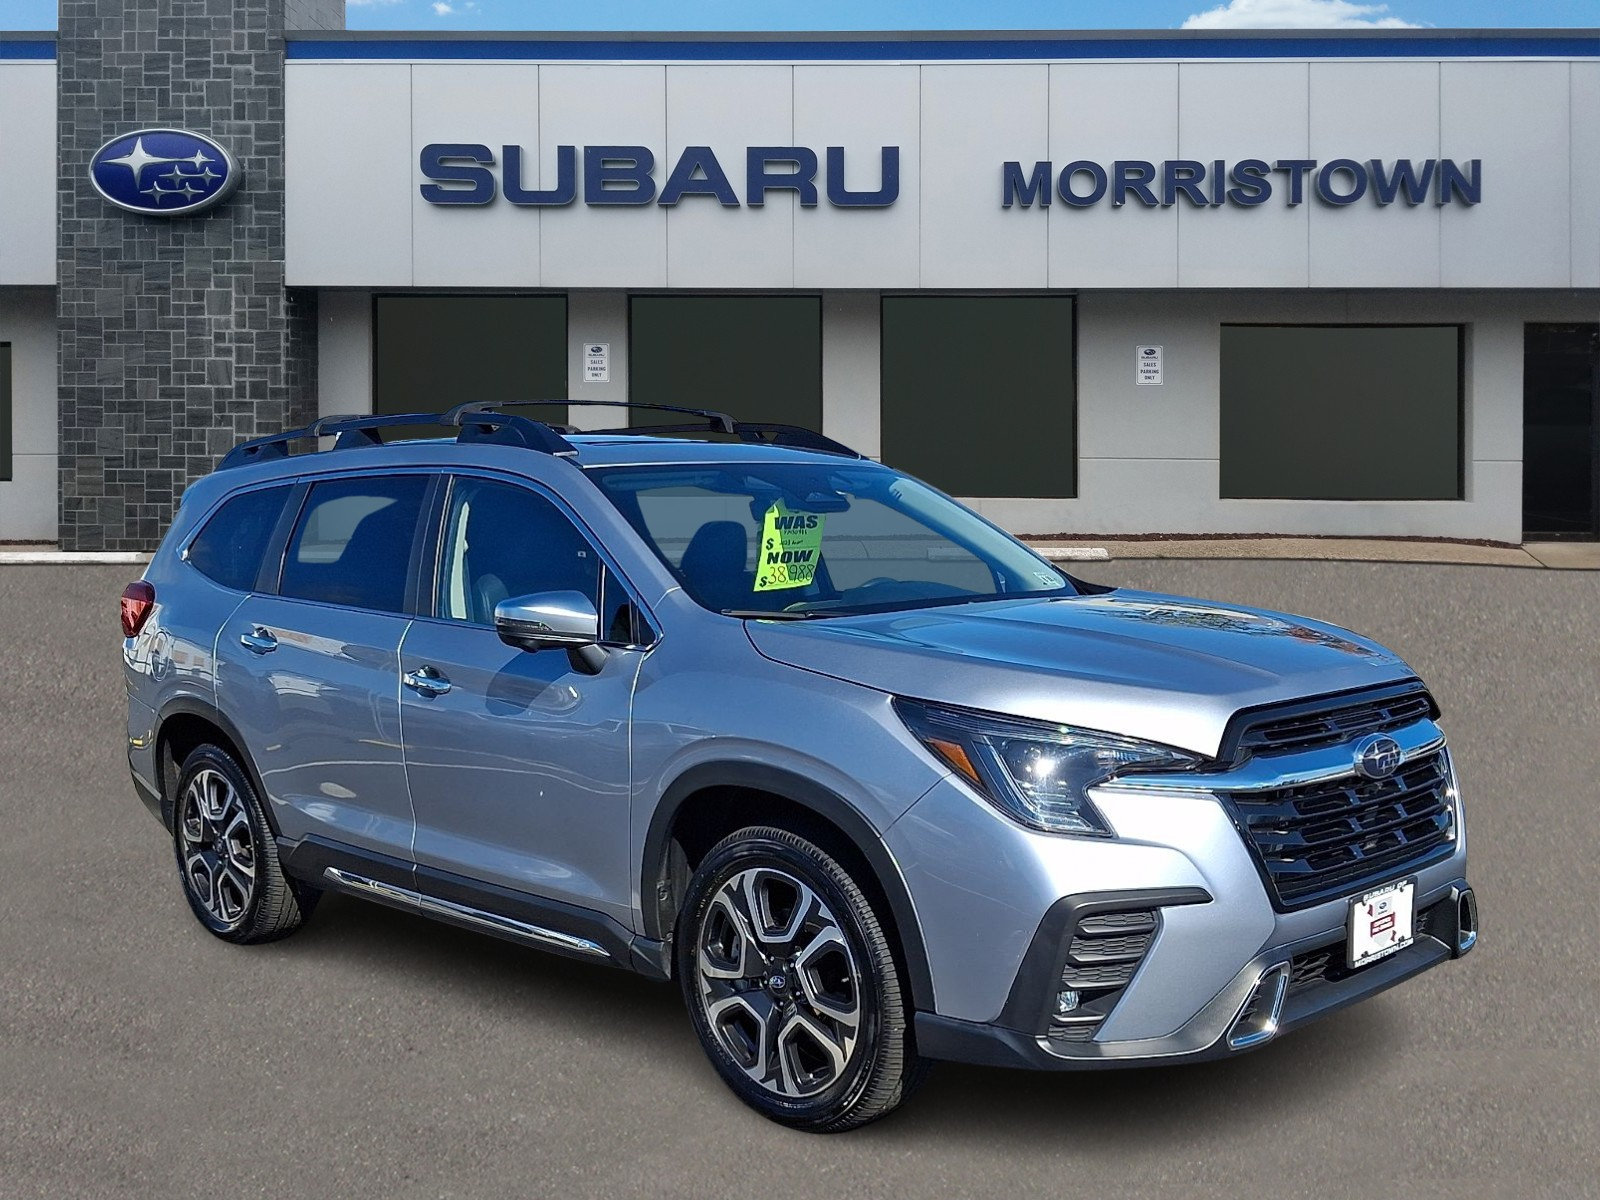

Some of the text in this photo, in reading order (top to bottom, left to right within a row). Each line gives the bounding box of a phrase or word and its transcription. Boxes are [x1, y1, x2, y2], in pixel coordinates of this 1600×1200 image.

[420, 143, 900, 207] SUBARU
[1001, 159, 1482, 209] MORRISTOWN
[775, 515, 818, 530] WAS
[766, 538, 774, 551] $
[767, 550, 813, 564] NOW
[1363, 880, 1407, 902] SUBARU OF
